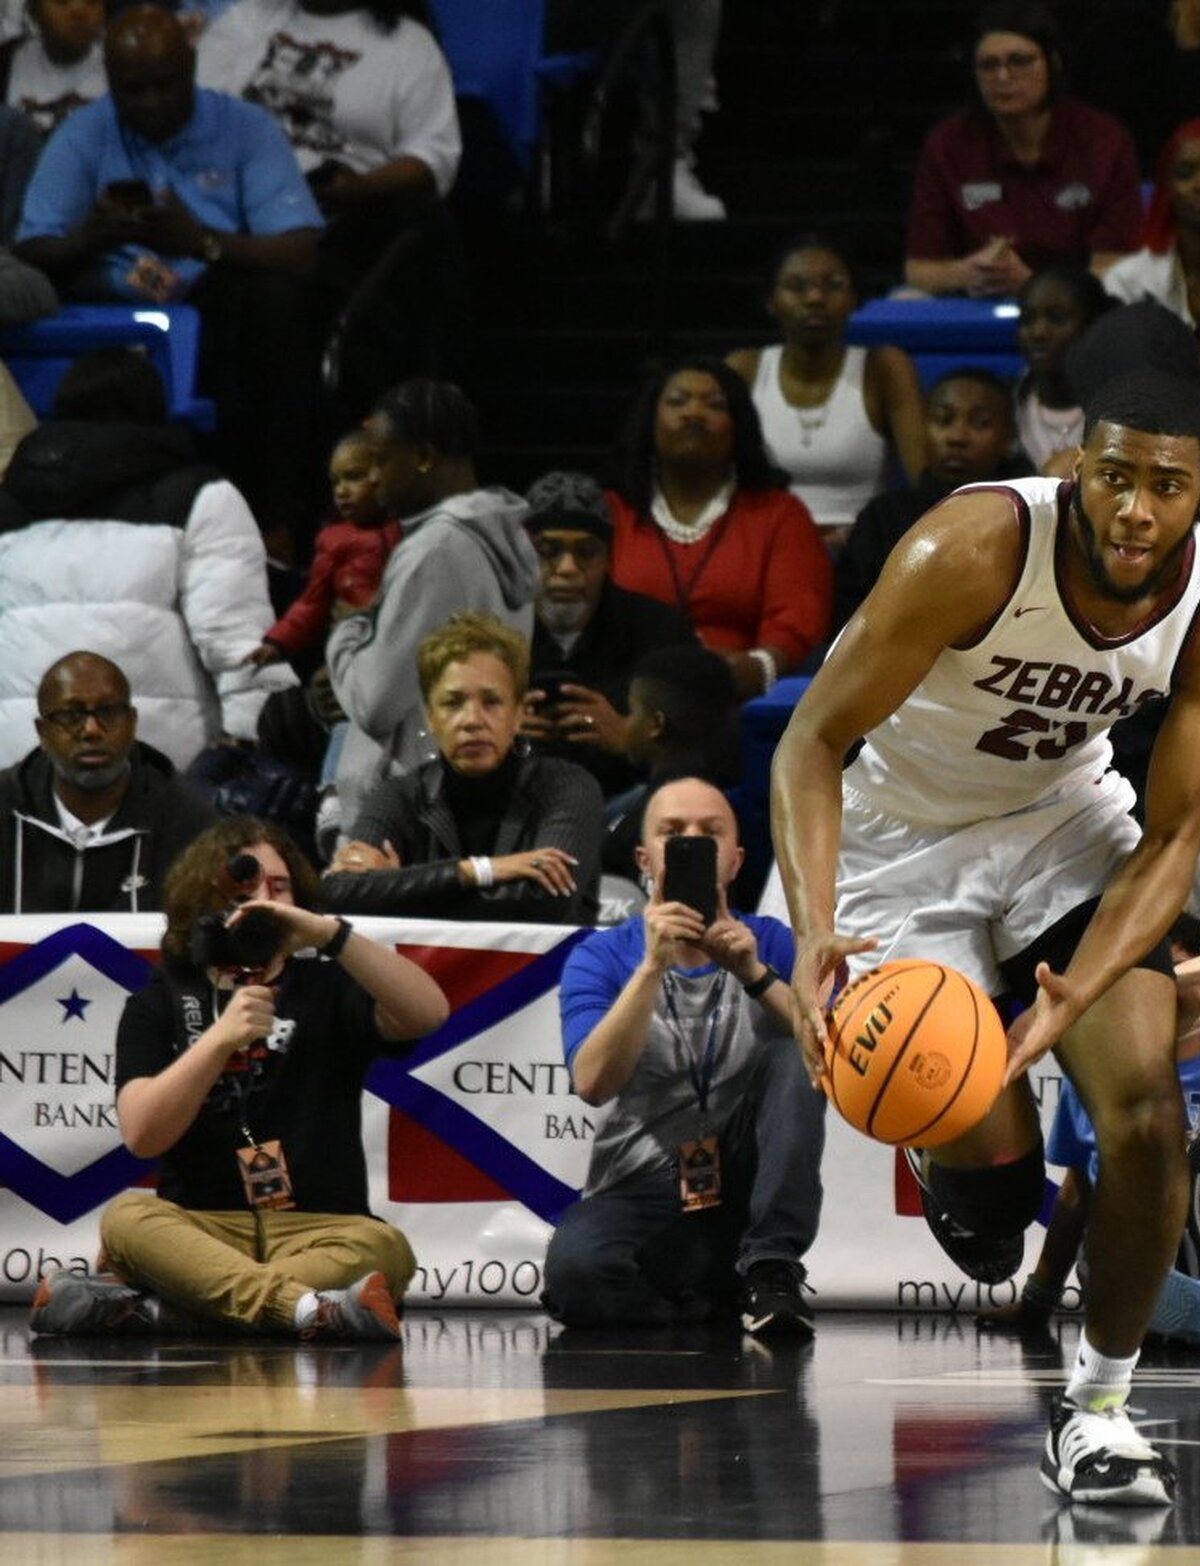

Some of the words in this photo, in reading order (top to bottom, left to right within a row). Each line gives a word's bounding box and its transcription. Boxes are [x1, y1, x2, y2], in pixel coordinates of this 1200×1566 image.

[598, 898, 637, 923] ZK
[453, 1061, 578, 1096] CENT
[34, 1102, 117, 1128] BANK
